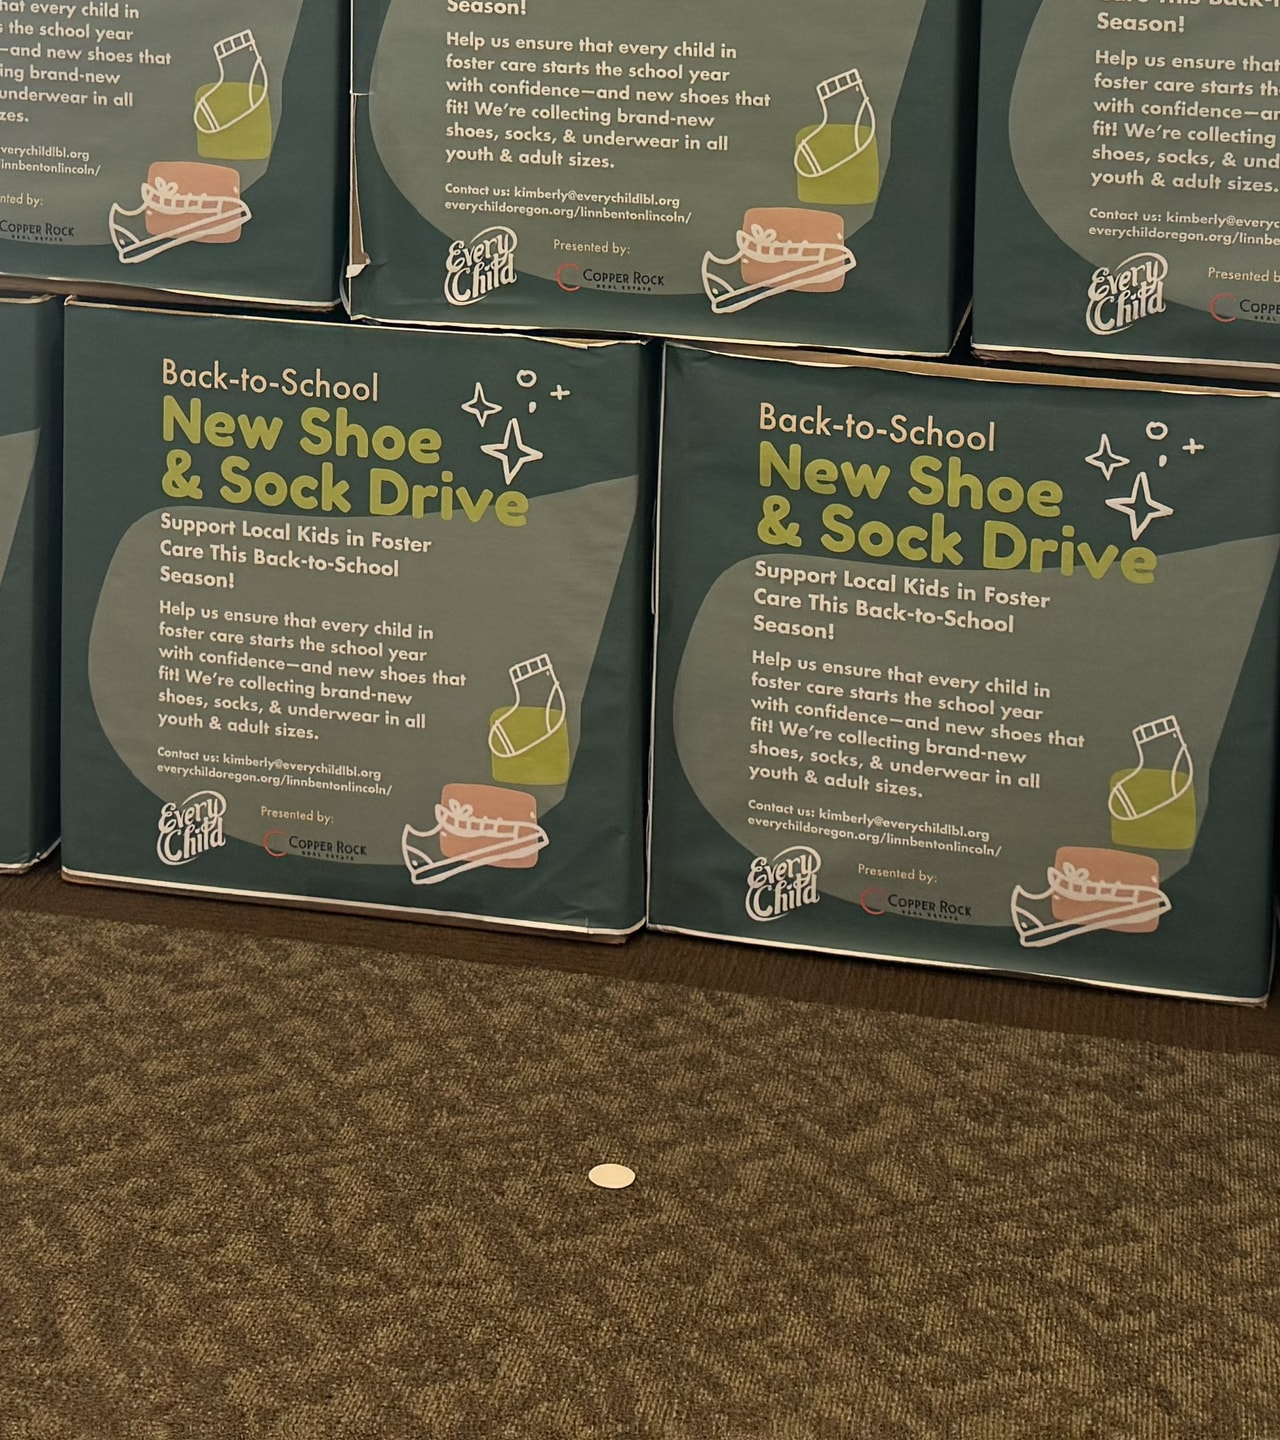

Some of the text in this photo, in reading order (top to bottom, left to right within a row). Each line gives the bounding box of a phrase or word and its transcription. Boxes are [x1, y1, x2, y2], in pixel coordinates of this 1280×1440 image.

[446, 52, 730, 84] foster care starts the school year
[92, 90, 108, 106] in
[112, 91, 133, 107] all
[1093, 97, 1134, 113] with
[444, 199, 692, 224] everychildoregon.org/linnbentonlincoln/
[162, 359, 378, 401] Back-to-School
[162, 395, 441, 465] New Shoe
[759, 403, 995, 451] Back-to-School
[161, 448, 529, 528] & Sock Drive
[759, 440, 1063, 518] New Shoe
[757, 494, 1157, 586] & Sock Drive
[159, 600, 434, 640] Help us ensure that every child in
[749, 716, 1027, 764] fit! We're collecting brand-new
